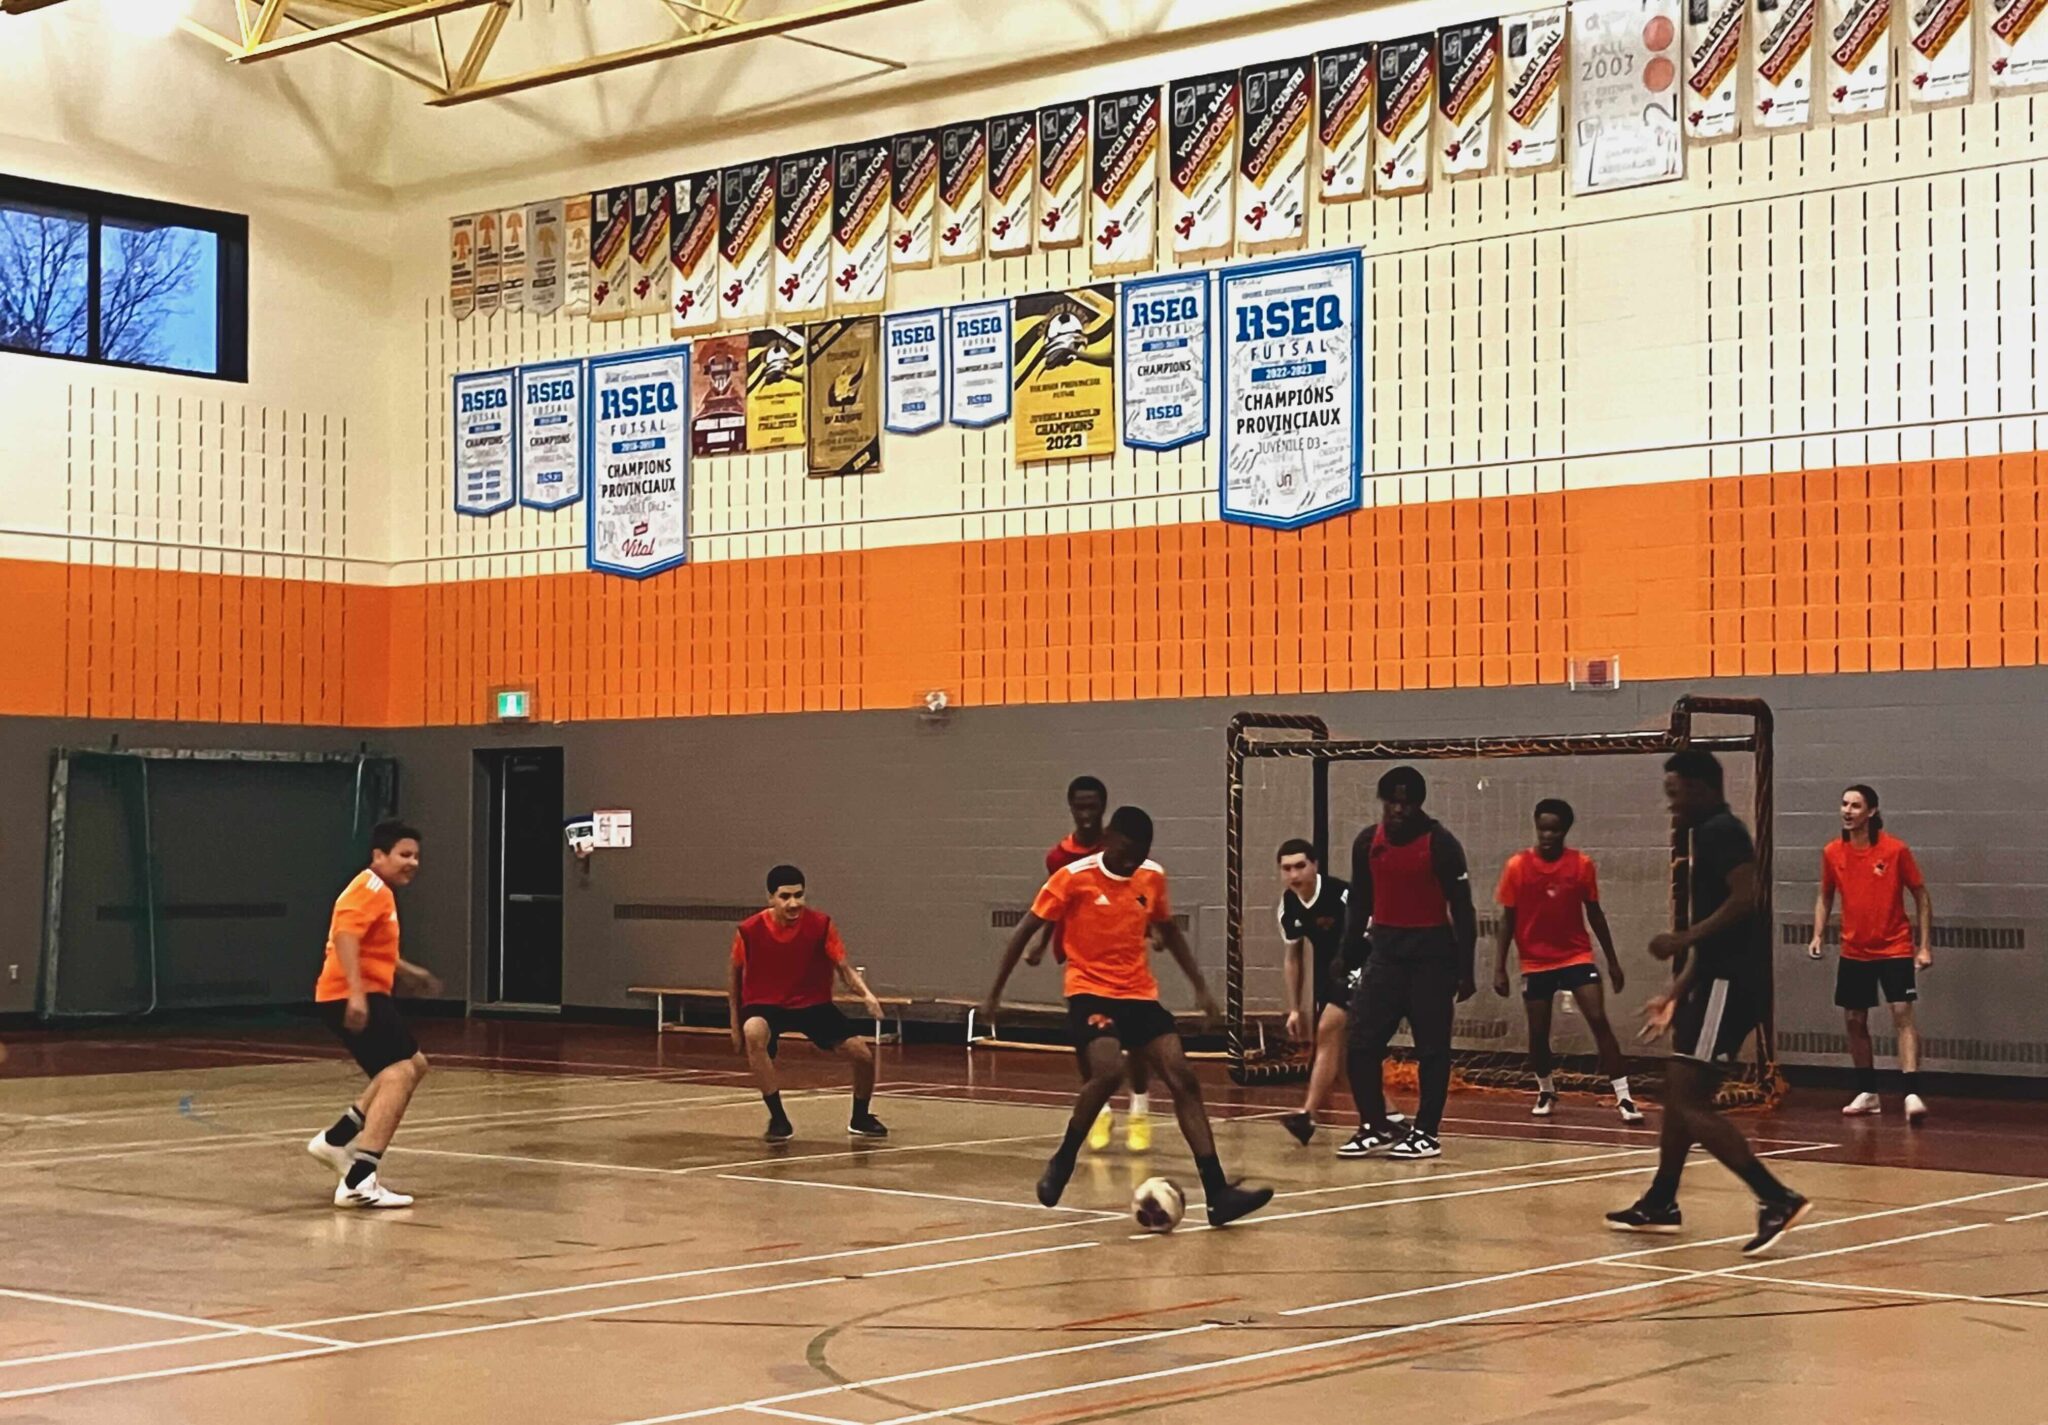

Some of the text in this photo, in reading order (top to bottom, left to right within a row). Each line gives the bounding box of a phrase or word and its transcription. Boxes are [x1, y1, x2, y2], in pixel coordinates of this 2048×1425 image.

[1508, 29, 1559, 99] BASKET-BALL
[1582, 54, 1634, 81] 2003
[1446, 48, 1494, 114] CHAMPIONS
[1514, 53, 1560, 117] CHAMPIONS
[1248, 66, 1306, 148] CROSS-COUNTRY
[1322, 76, 1369, 140] CHAMPIONNES
[1383, 67, 1431, 132] CHAMPIONS
[1100, 135, 1126, 171] SOCCER
[1132, 93, 1156, 123] SALLE
[1176, 82, 1233, 159] VOLLEY-BALL
[1247, 91, 1309, 175] CHAMPIONNES
[994, 121, 1030, 176] BASKET-BALL
[1100, 117, 1156, 194] CHAMPIONS
[1177, 103, 1233, 184] CHAMPIONS
[780, 156, 829, 226] BADMINTON
[839, 146, 888, 217] BADMINTON
[725, 197, 751, 233] HOCKEY
[748, 165, 771, 198] COSOM
[781, 178, 831, 249] CHAMPIONS
[838, 168, 891, 239] CHAMPIONNES
[725, 185, 776, 256] CHAMPIONS
[1132, 296, 1199, 328] RSEQ
[1236, 294, 1344, 343] RSEQ
[891, 325, 936, 347] RSEQ
[957, 316, 1003, 338] RSEQ
[1140, 325, 1189, 339] FUTSAL
[1251, 339, 1328, 362] FUTSAL
[1137, 360, 1192, 377] CHAMPIONS
[1265, 363, 1313, 379] 2022-2023
[461, 388, 507, 413] RSEQ
[527, 380, 575, 405] RSEQ
[600, 381, 678, 420] RSEQ
[1244, 385, 1334, 412] CHAMPIONS
[1146, 404, 1183, 421] RSEQ
[1236, 408, 1341, 435] PROVINCIAUX
[465, 435, 504, 449] CHAMPIONS
[529, 433, 571, 447] CHAMPIONS
[611, 420, 666, 436] FUTSAL
[1035, 419, 1095, 436] CHAMPIONS
[1046, 434, 1083, 450] 2023
[1258, 436, 1321, 455] JUVÉNILE D3
[607, 458, 671, 478] CHAMPIONS
[601, 478, 676, 499] PROVINCIAUX
[622, 537, 656, 558] Vital
